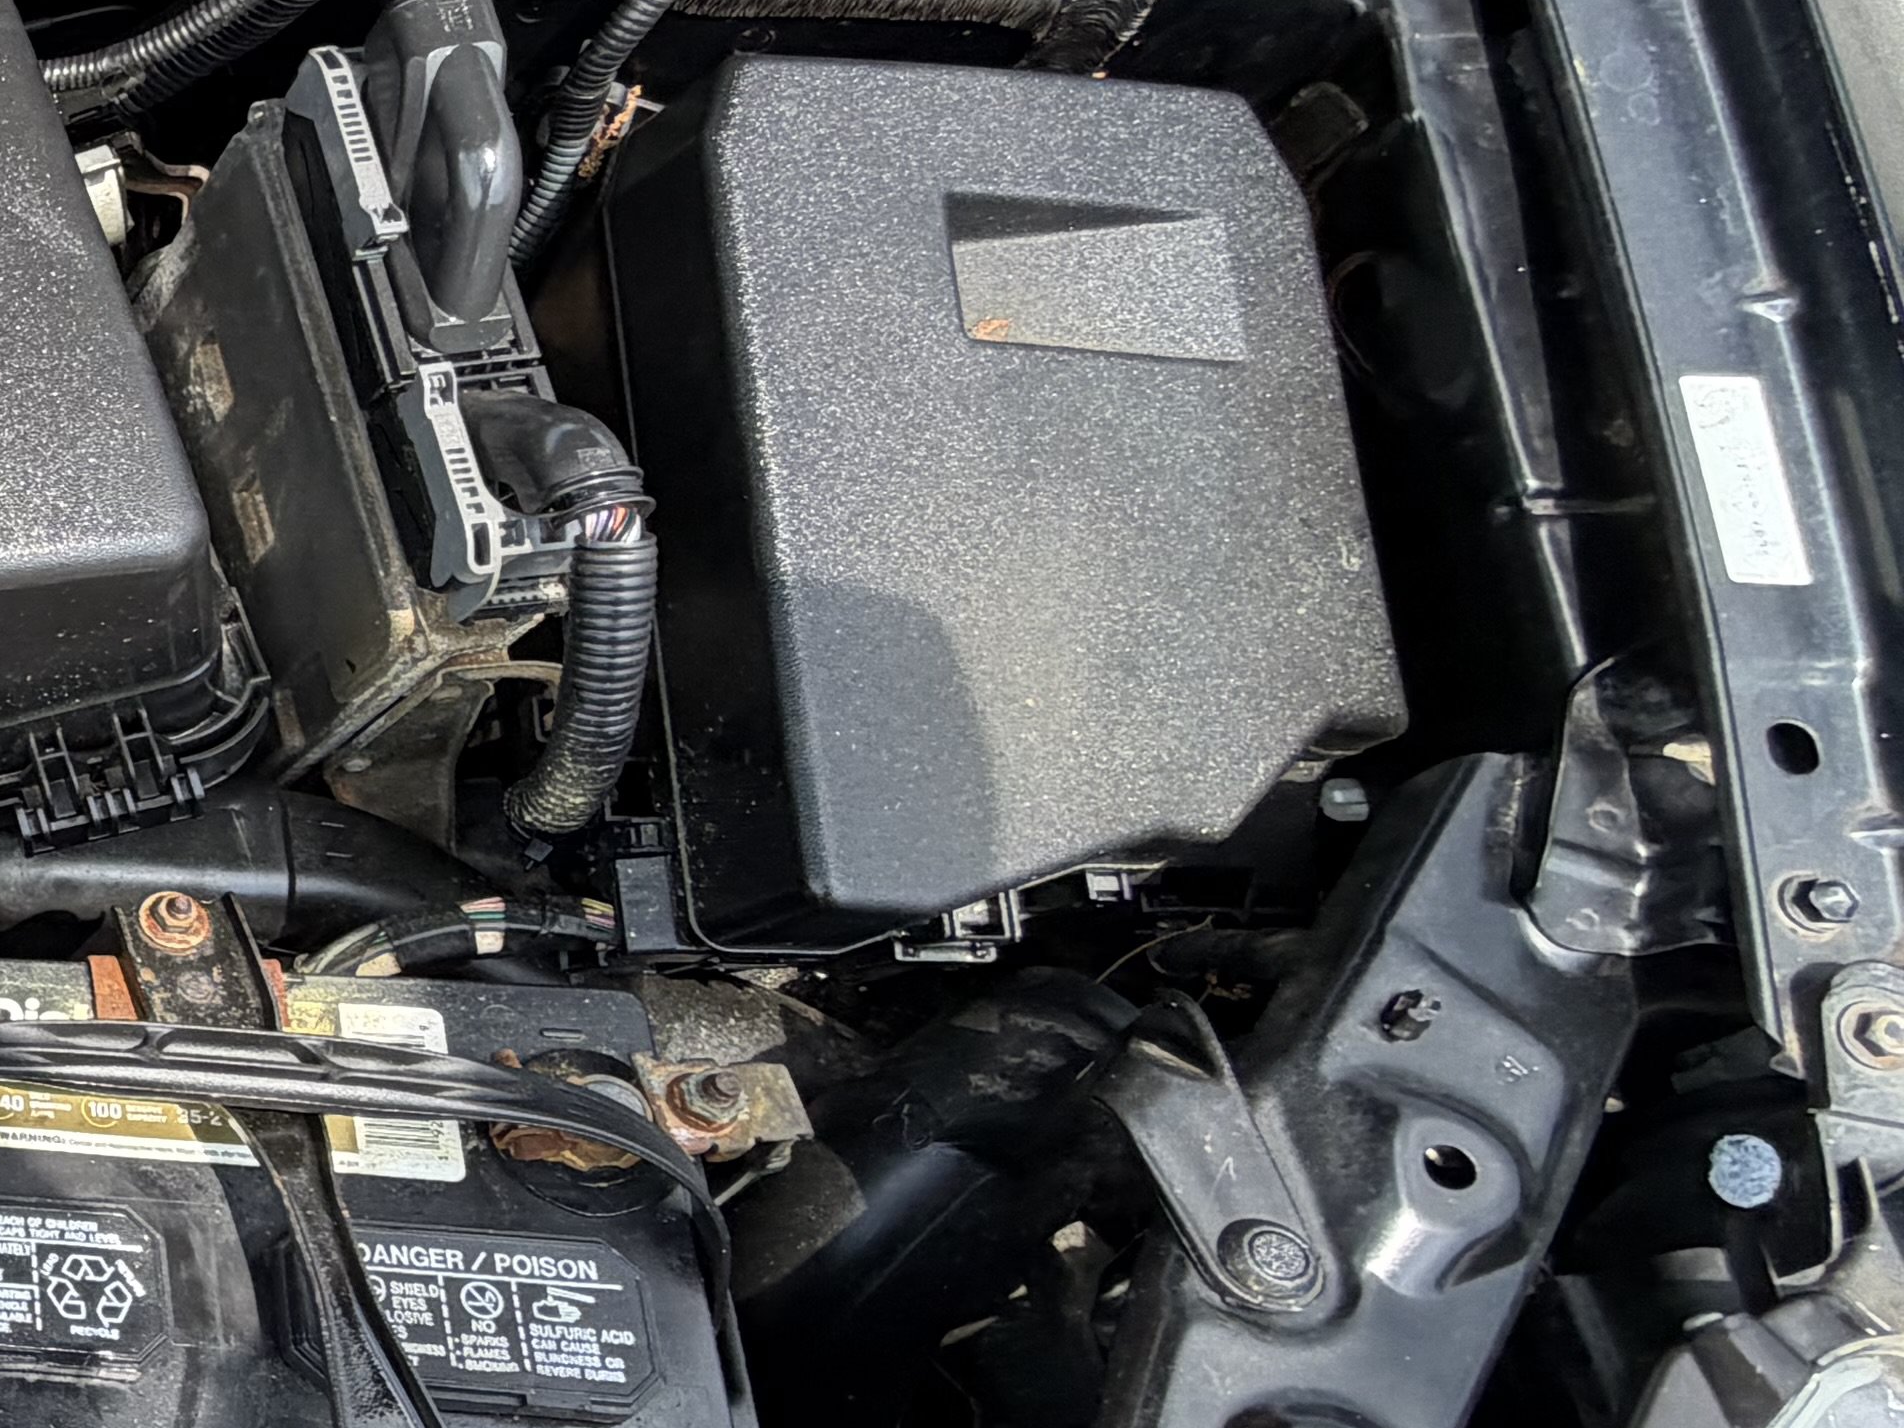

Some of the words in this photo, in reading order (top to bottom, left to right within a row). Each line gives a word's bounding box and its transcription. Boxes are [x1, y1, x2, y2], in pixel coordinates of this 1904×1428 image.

[88, 1101, 123, 1119] 100
[64, 1231, 87, 1242] AND
[357, 1242, 465, 1271] DANGER
[470, 1251, 487, 1272] /
[493, 1252, 599, 1281] POISON
[389, 1280, 440, 1298] SHIELD
[391, 1296, 428, 1312] EYES
[385, 1309, 435, 1327] LOSIVE
[471, 1318, 497, 1334] NO
[460, 1333, 510, 1348] SPARKS
[529, 1322, 597, 1342] SULFURIC
[600, 1329, 636, 1346] ACID
[462, 1346, 512, 1360] FLAMES
[531, 1338, 557, 1350] CAN
[560, 1340, 602, 1355] CAUSE
